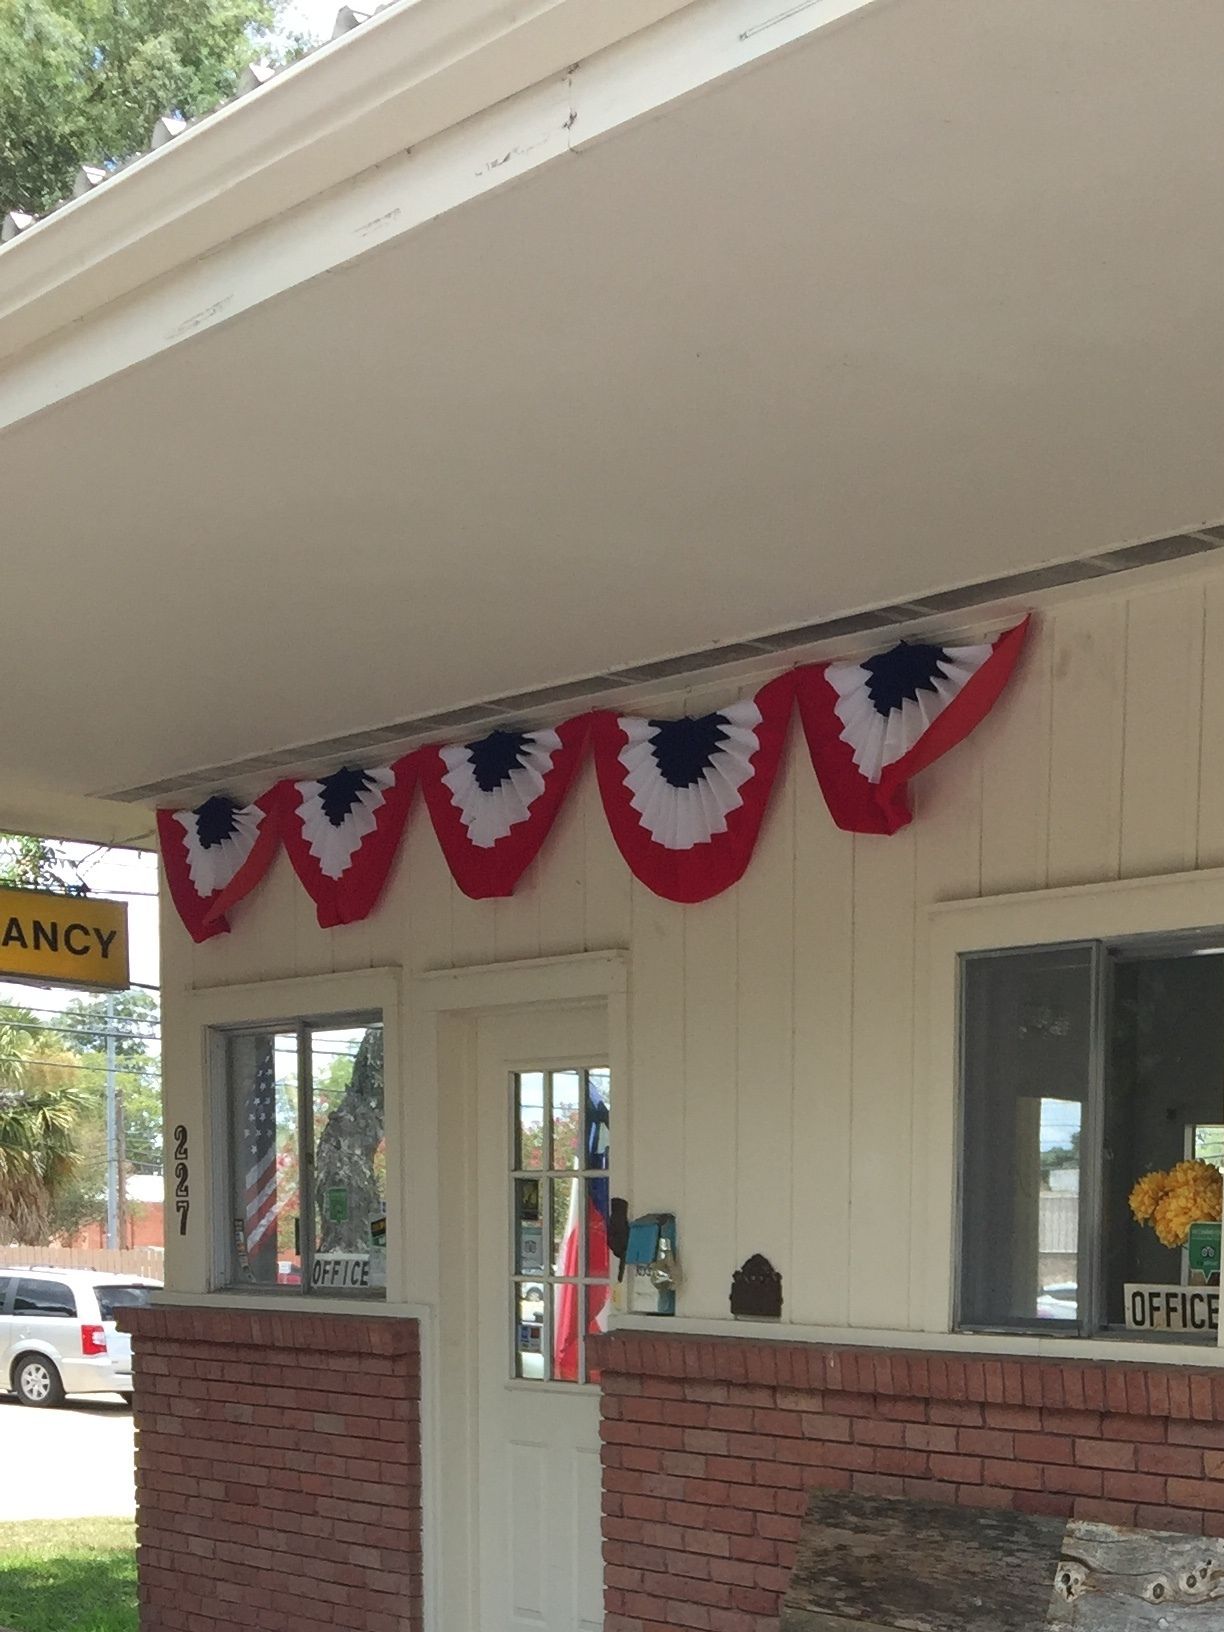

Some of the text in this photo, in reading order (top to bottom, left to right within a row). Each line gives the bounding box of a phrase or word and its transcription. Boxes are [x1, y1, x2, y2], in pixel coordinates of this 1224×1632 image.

[1, 916, 117, 959] ANCY
[173, 1124, 190, 1236] 227
[312, 1260, 369, 1286] OFFICE
[1131, 1290, 1220, 1330] OFFICE
